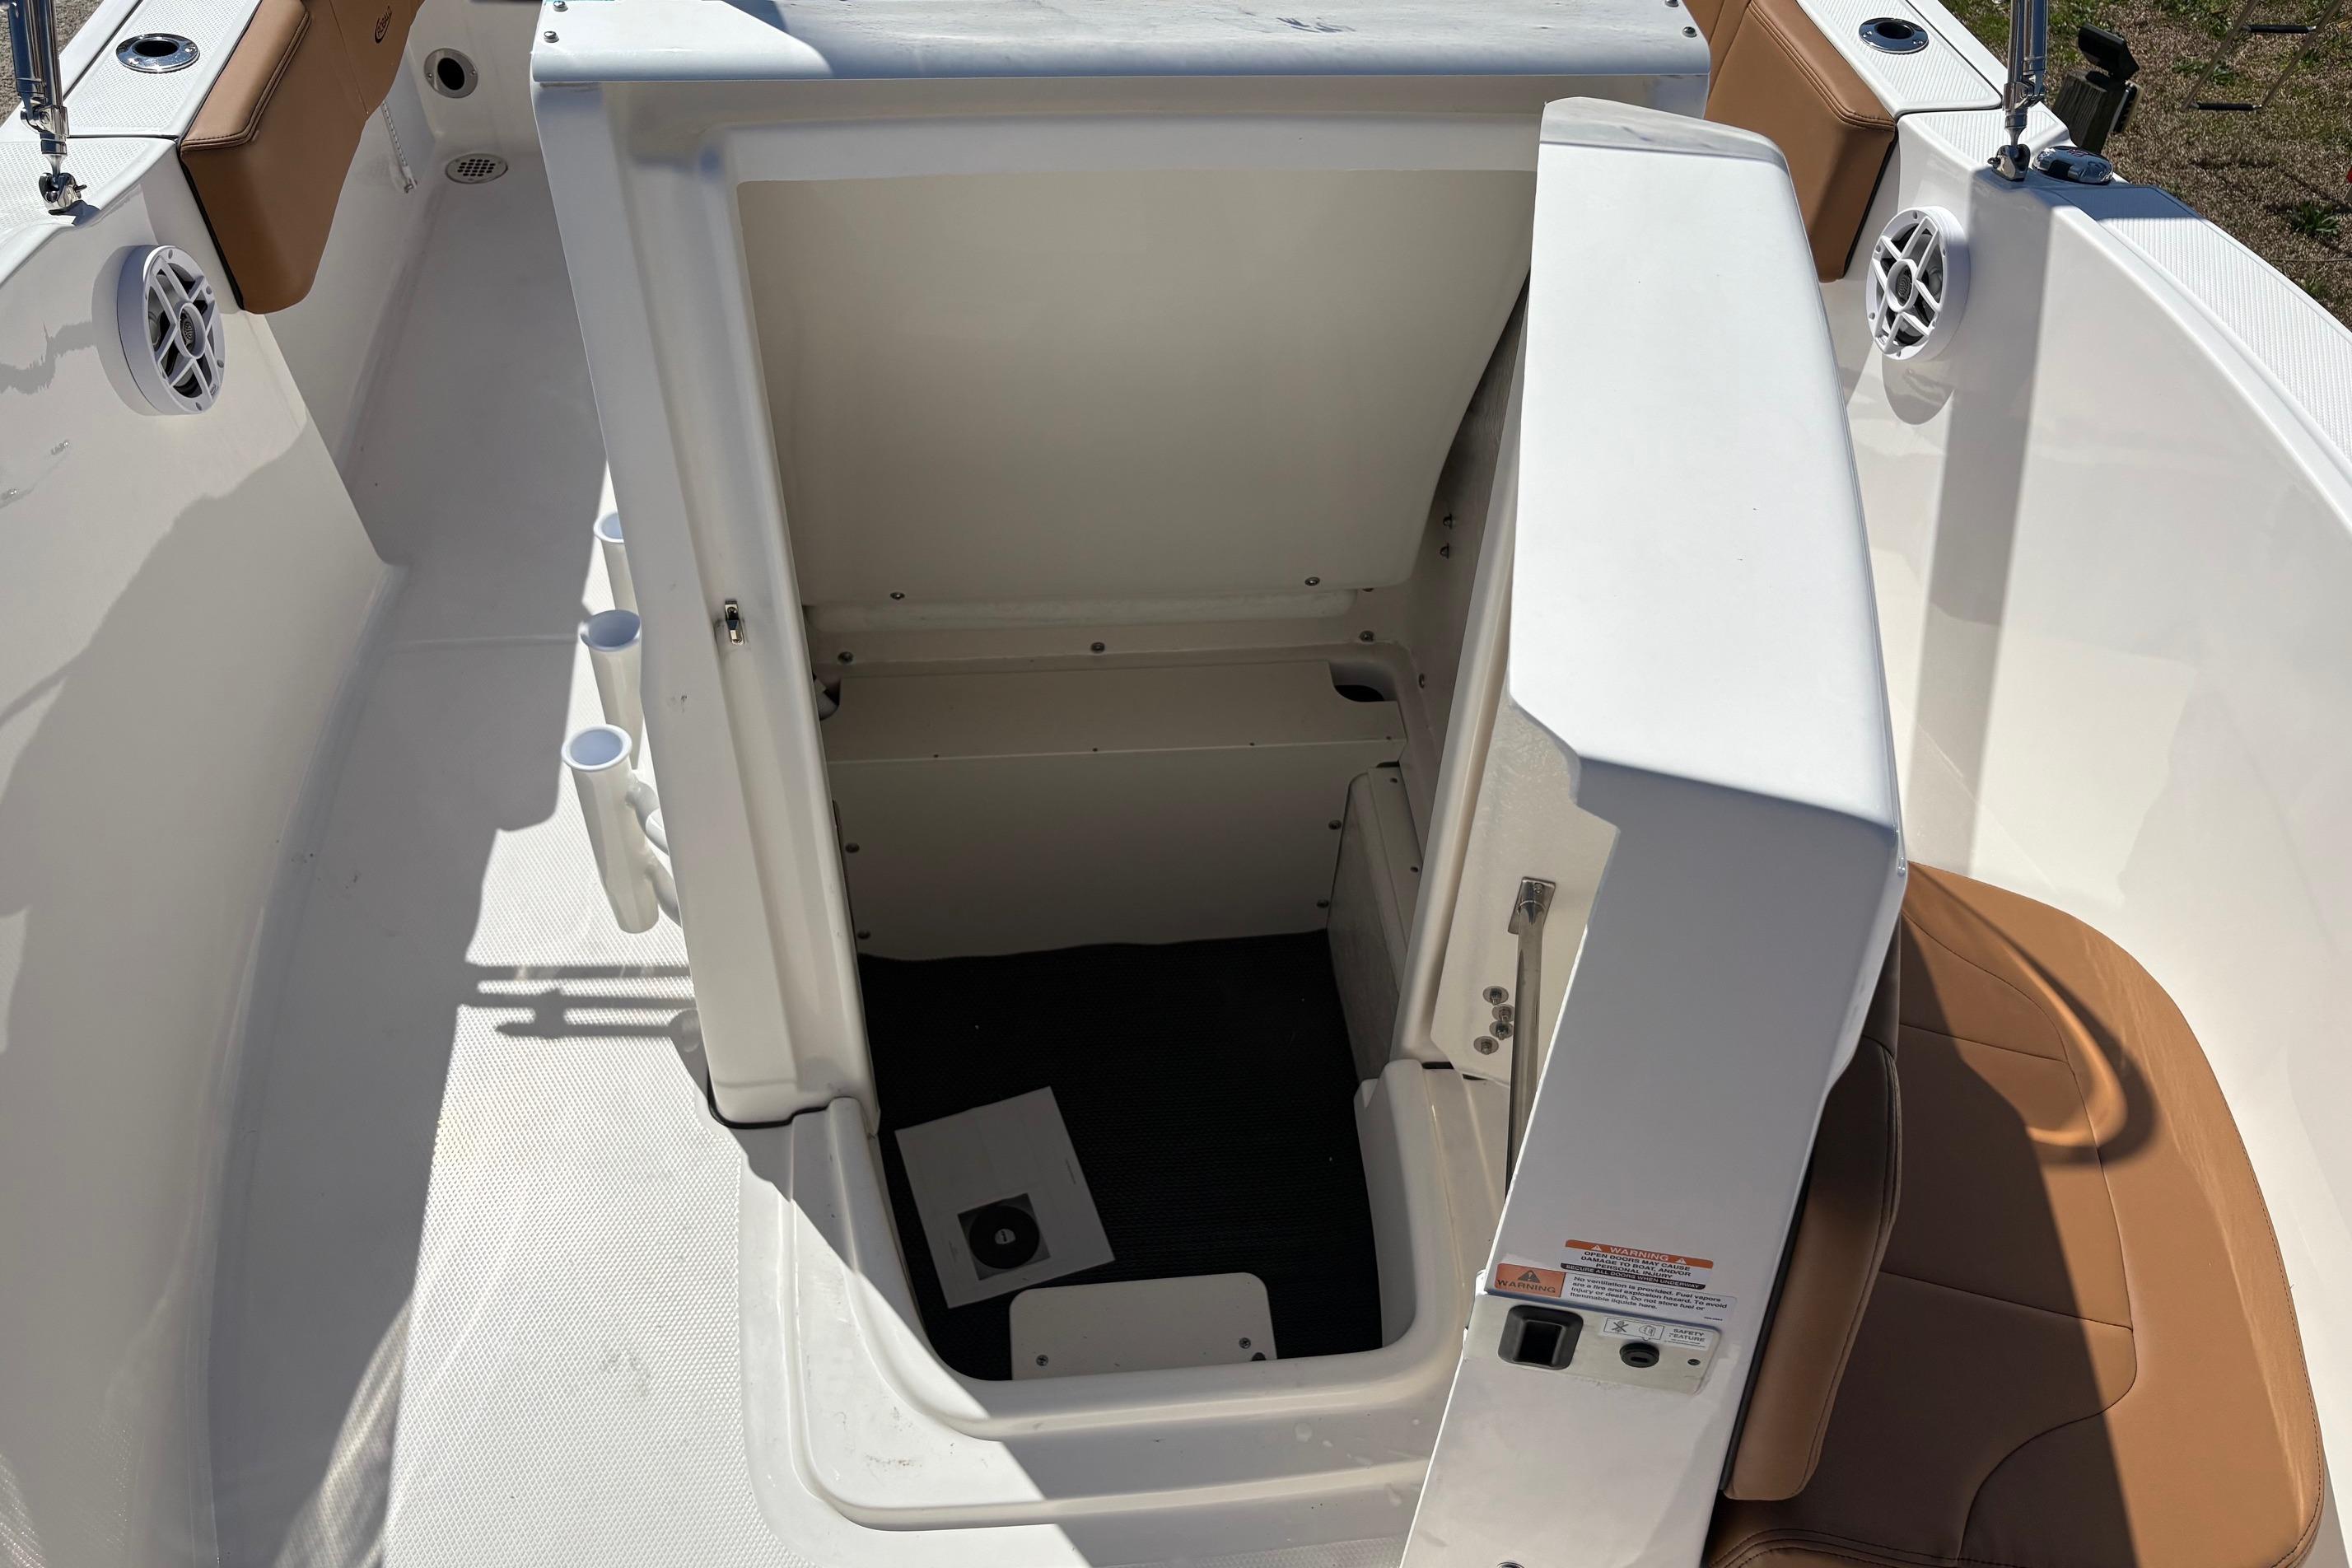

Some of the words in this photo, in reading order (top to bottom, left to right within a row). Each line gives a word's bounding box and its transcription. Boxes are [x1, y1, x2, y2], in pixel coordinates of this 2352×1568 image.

[1610, 1247, 1669, 1261] WARNING
[1610, 1255, 1640, 1263] DOORS
[1581, 1256, 1617, 1265] DAMAGE
[1659, 1268, 1692, 1276] AND/OR
[1596, 1263, 1640, 1274] PERSONAL
[1566, 1264, 1595, 1272] SECURE
[1660, 1279, 1699, 1288] UNDERWAY
[1498, 1280, 1556, 1293] WARNING
[1587, 1279, 1627, 1289] ventilation
[1637, 1286, 1673, 1295] provided.
[1570, 1292, 1609, 1302] flammable
[1612, 1298, 1637, 1306] liquids
[1624, 1290, 1661, 1300] explosion
[1664, 1295, 1692, 1304] hazard.
[1673, 1328, 1705, 1337] SAFETY
